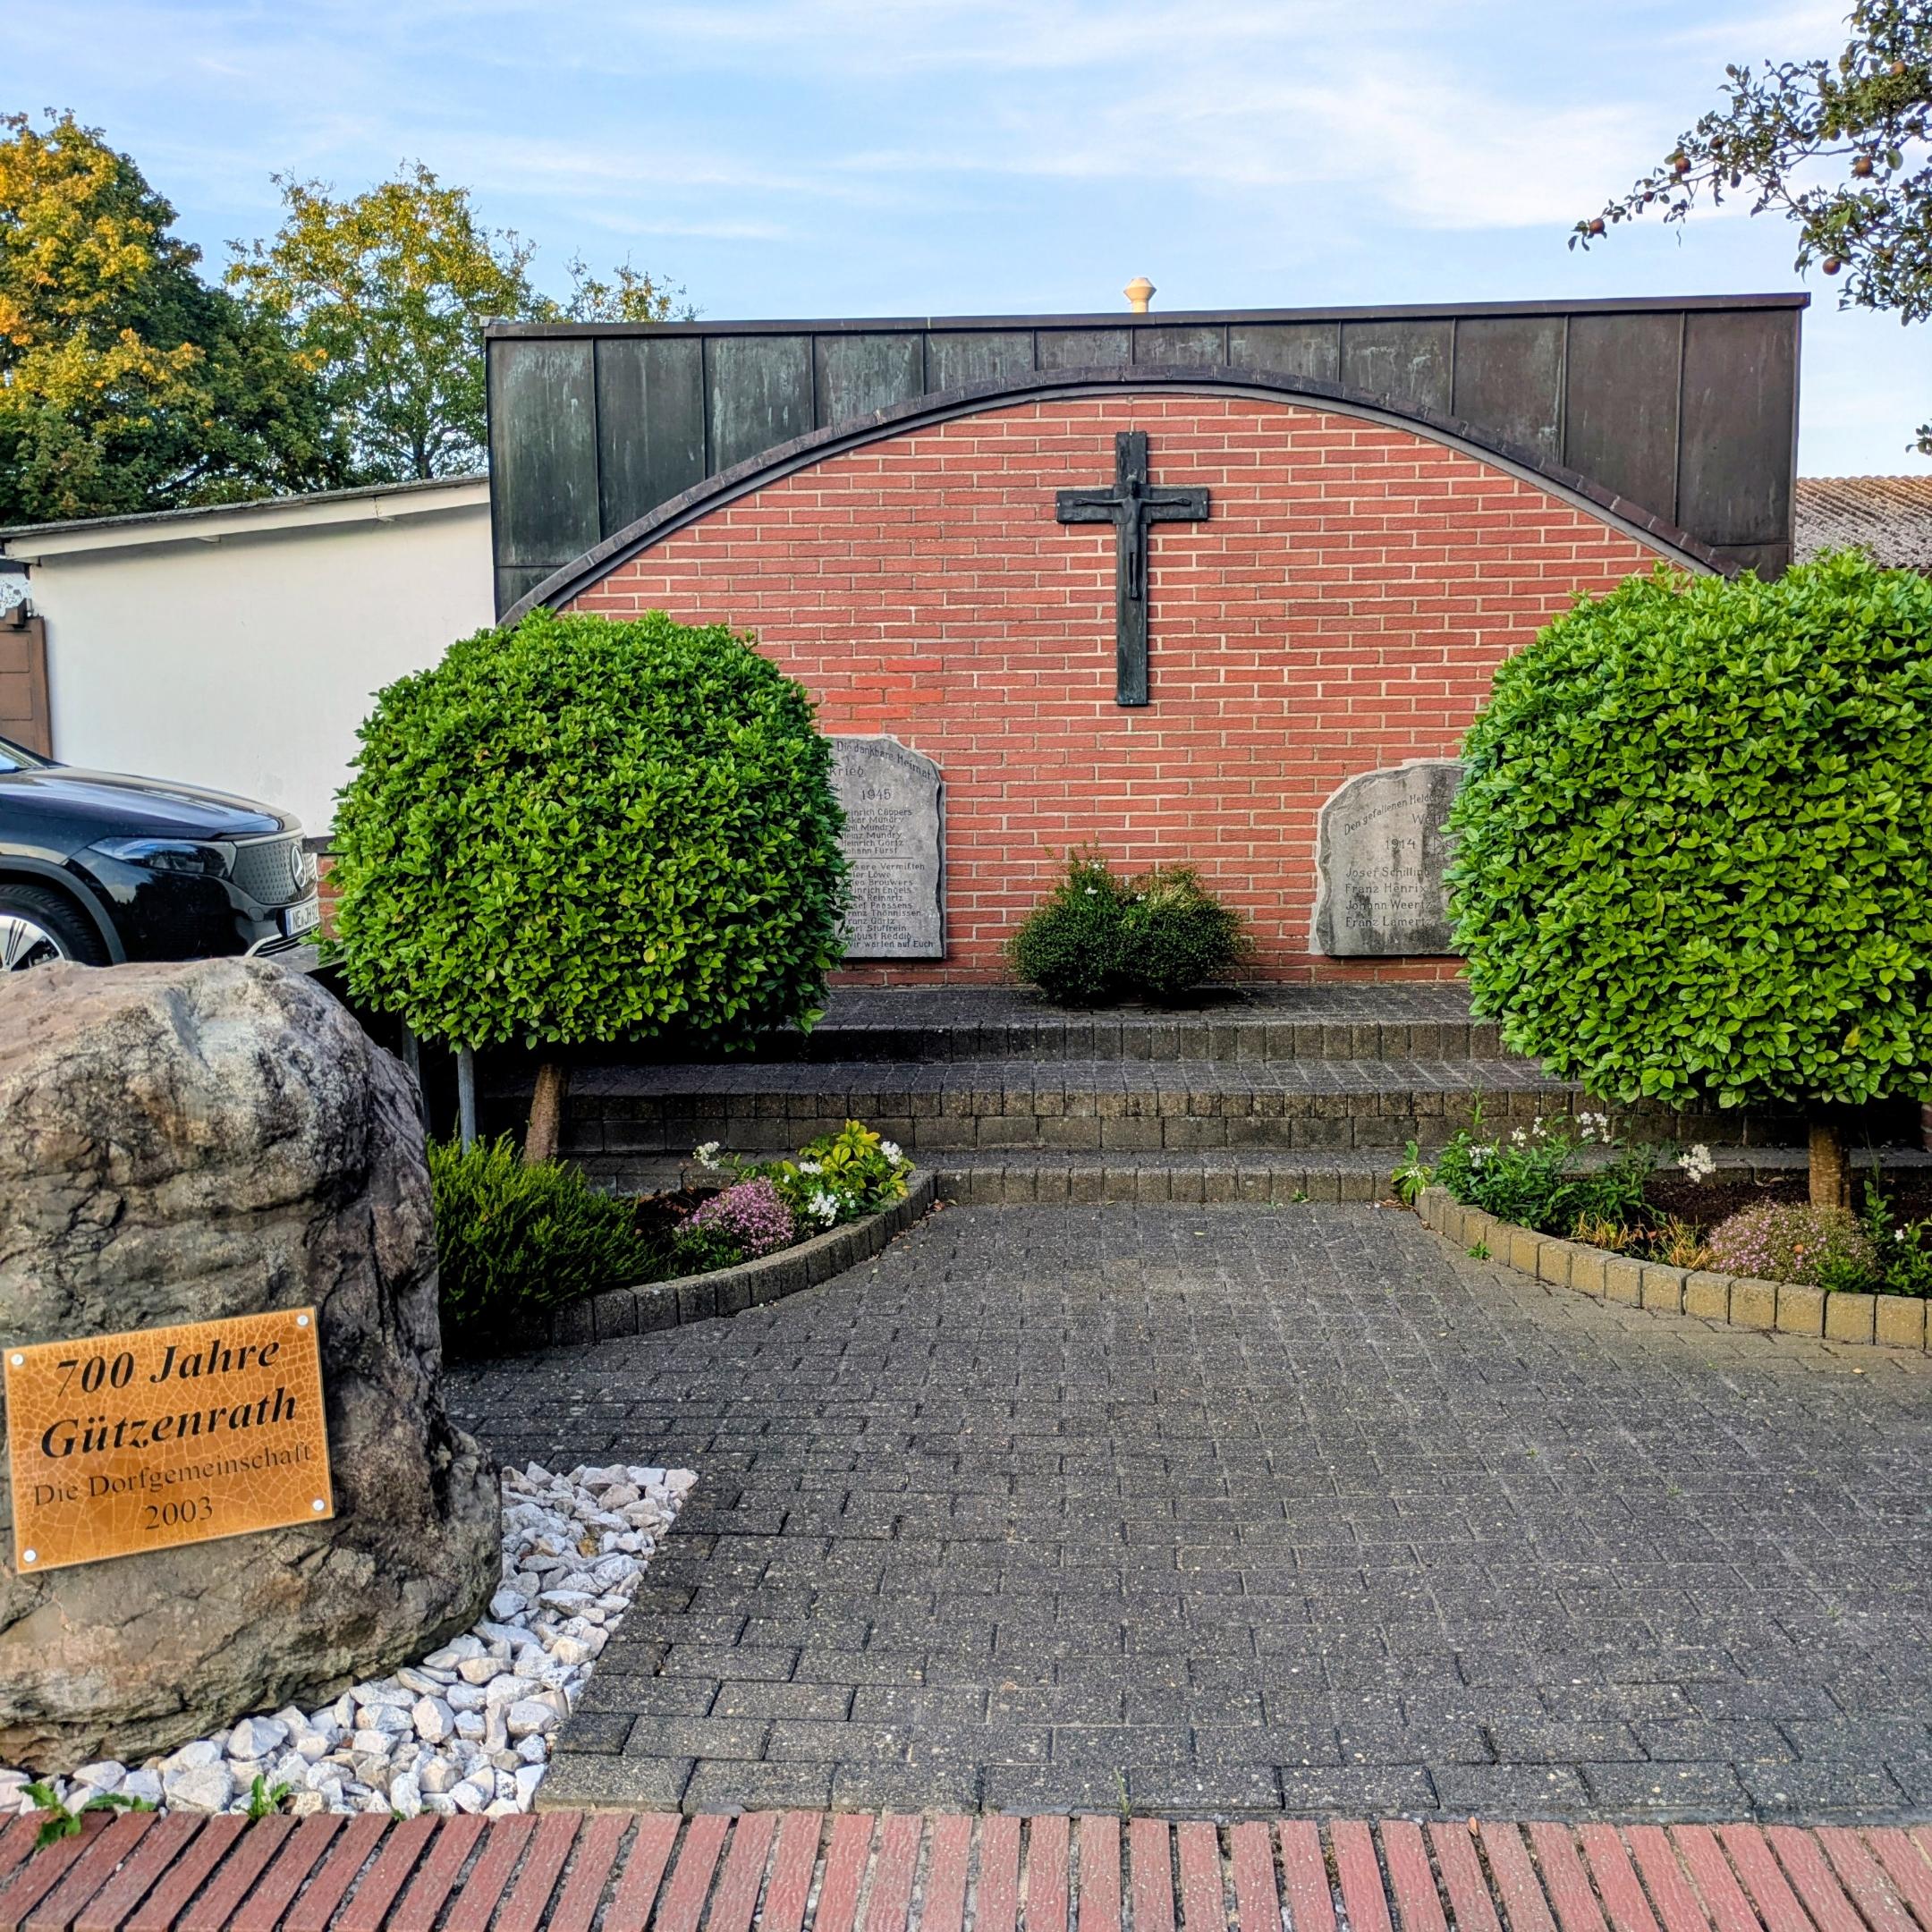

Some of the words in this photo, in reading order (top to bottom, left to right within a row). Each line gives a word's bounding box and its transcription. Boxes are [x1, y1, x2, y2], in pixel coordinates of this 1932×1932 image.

[836, 741, 852, 751] Die
[854, 743, 894, 760] dankbare
[897, 753, 931, 780] Heimat
[861, 788, 892, 801] 1945
[1343, 820, 1361, 835] Den
[1362, 799, 1408, 826] gefallenen
[1385, 838, 1416, 850] 1914
[1345, 867, 1378, 877] Josef
[1381, 866, 1430, 878] Schilling
[1344, 883, 1379, 894] Franz
[1384, 882, 1427, 894] Henrix
[1345, 900, 1387, 911] Johann
[1345, 916, 1378, 928] Franz
[55, 1351, 135, 1397] 700
[150, 1339, 281, 1384] Jahre
[40, 1387, 297, 1458] Gützenrath
[34, 1483, 80, 1506] Die
[89, 1441, 312, 1498] Dorfgemeinschaft
[144, 1496, 214, 1530] 2003
